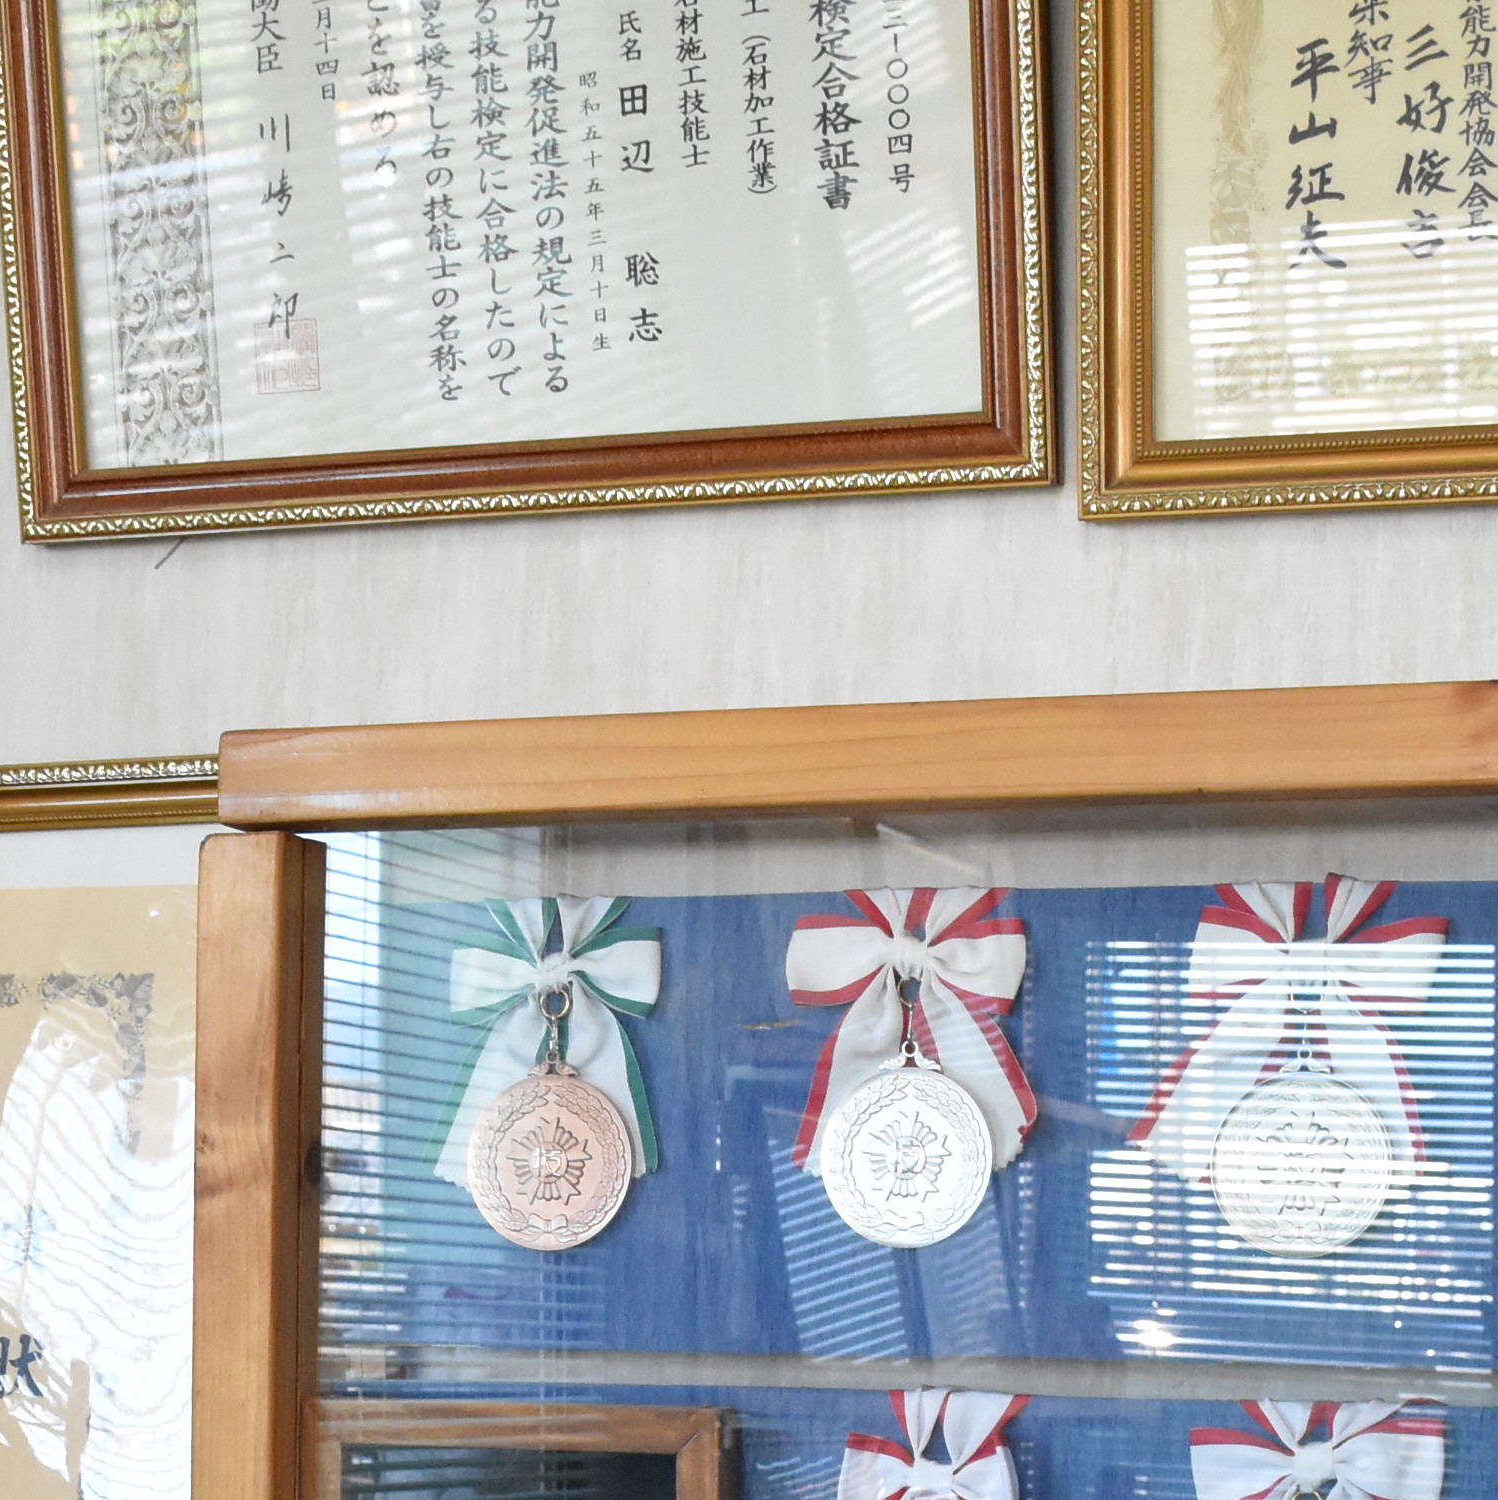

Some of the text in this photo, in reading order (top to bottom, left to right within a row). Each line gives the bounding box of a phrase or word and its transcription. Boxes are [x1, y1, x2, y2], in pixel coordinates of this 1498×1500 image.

[468, 0, 522, 397] る技能検定に合格したので
[523, 0, 574, 394] 力開発促進法の規定による
[579, 71, 612, 352] 昭和五十五年三月十日生
[618, 10, 664, 343] 氏名 田辺 聡志
[808, 0, 862, 210] 検定合格証書
